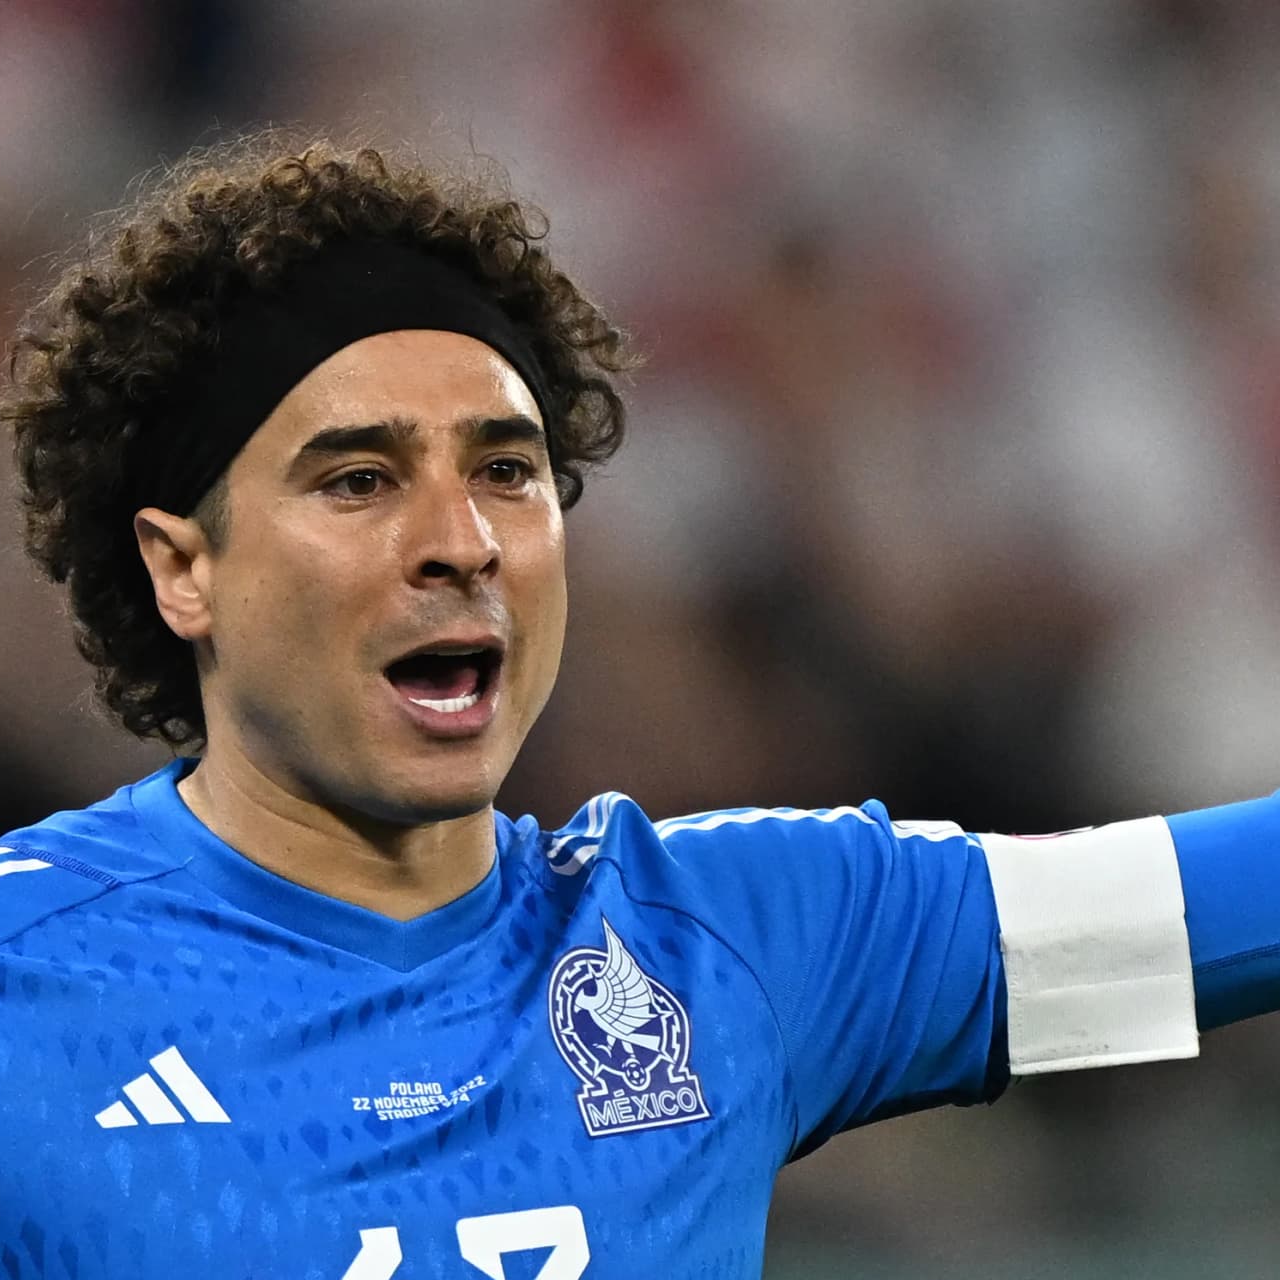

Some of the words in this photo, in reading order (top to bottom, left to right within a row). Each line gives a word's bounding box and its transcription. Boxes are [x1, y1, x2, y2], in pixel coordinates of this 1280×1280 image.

[352, 1097, 371, 1110] 22
[373, 1094, 447, 1109] NOVEMBER
[450, 1075, 487, 1098] 2022
[389, 1082, 442, 1096] POLAND
[376, 1105, 440, 1121] STADIUM
